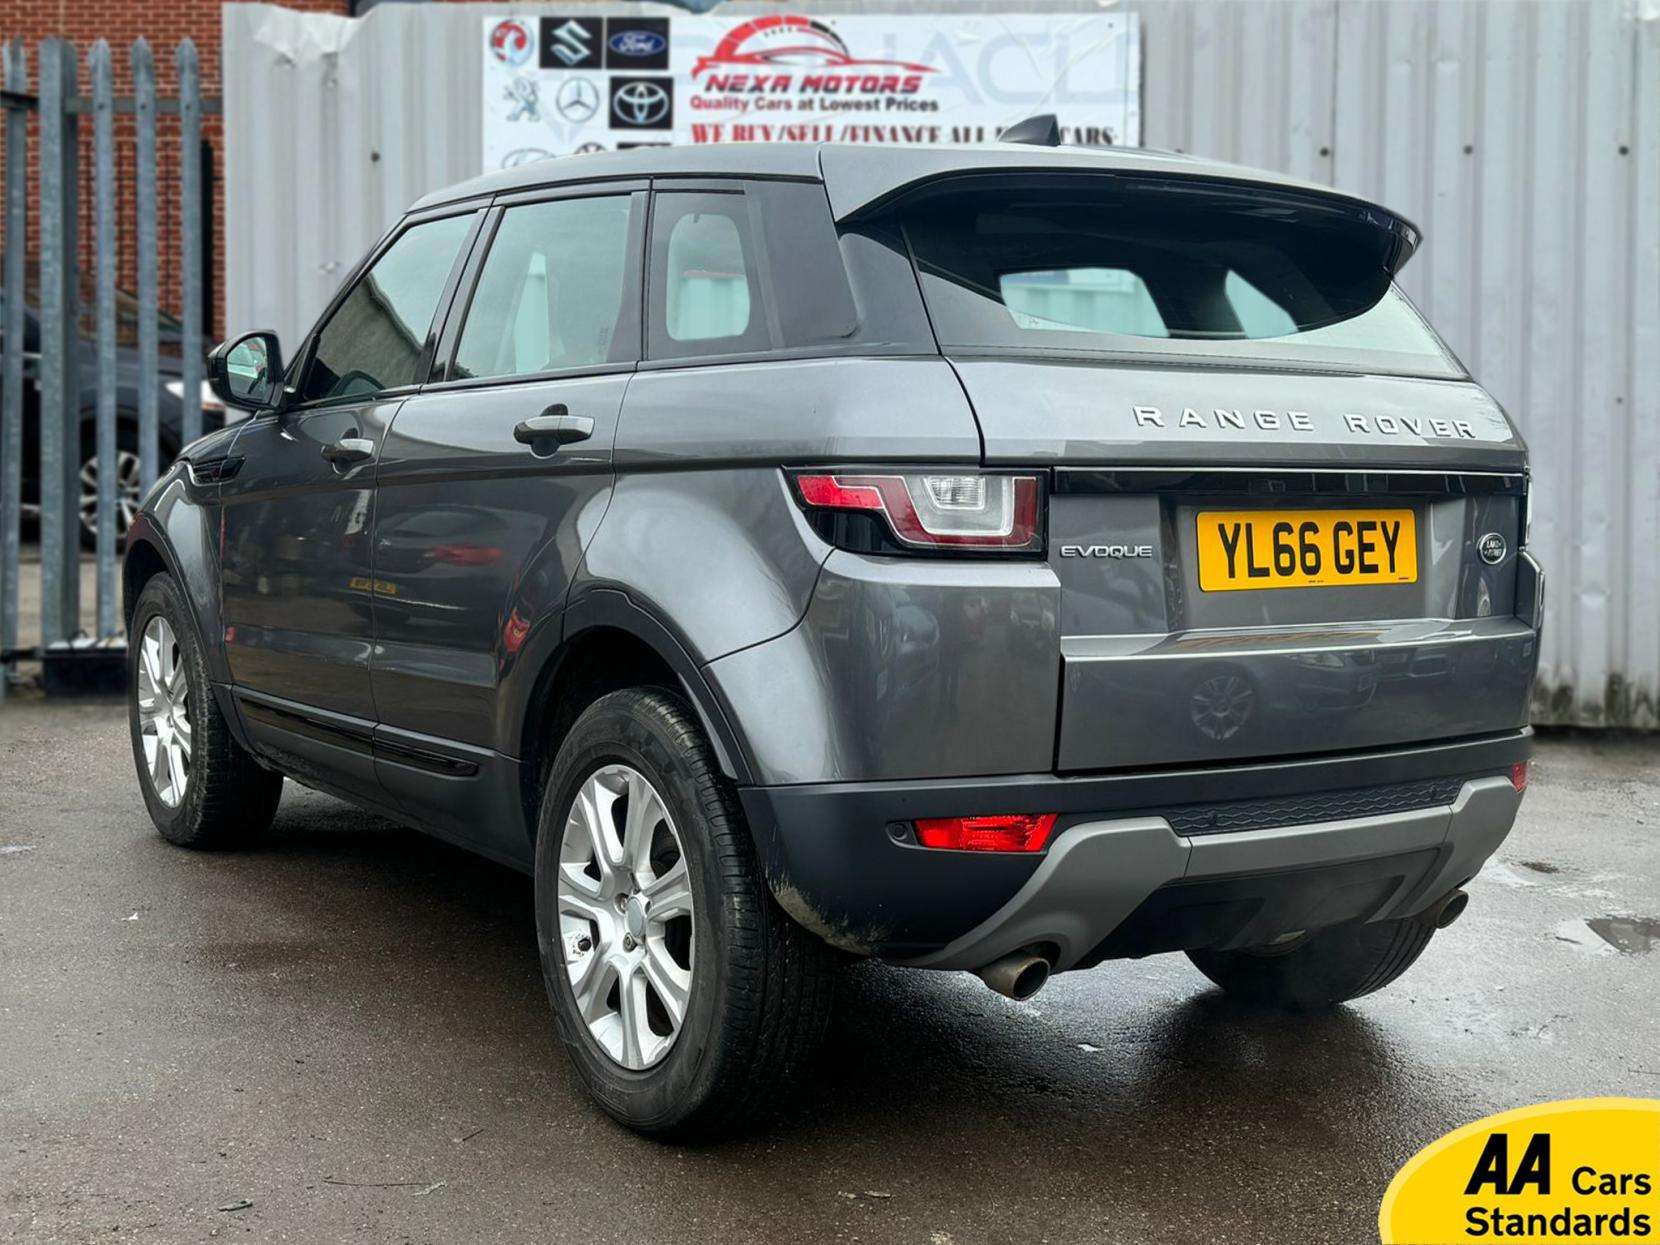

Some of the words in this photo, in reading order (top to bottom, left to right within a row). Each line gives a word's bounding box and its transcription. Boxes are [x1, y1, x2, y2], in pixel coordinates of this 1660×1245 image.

[704, 75, 792, 92] NEXA
[800, 75, 922, 93] MOTORS
[690, 96, 749, 112] Quality
[754, 97, 793, 110] Cars
[798, 99, 814, 110] at
[820, 98, 880, 110] Lowest
[886, 98, 939, 111] Prices
[1133, 404, 1315, 431] RANGE
[1343, 414, 1476, 439] ROVER
[1060, 545, 1153, 560] EVOQUE
[1218, 521, 1322, 579] YL66
[1333, 520, 1400, 575] GEY
